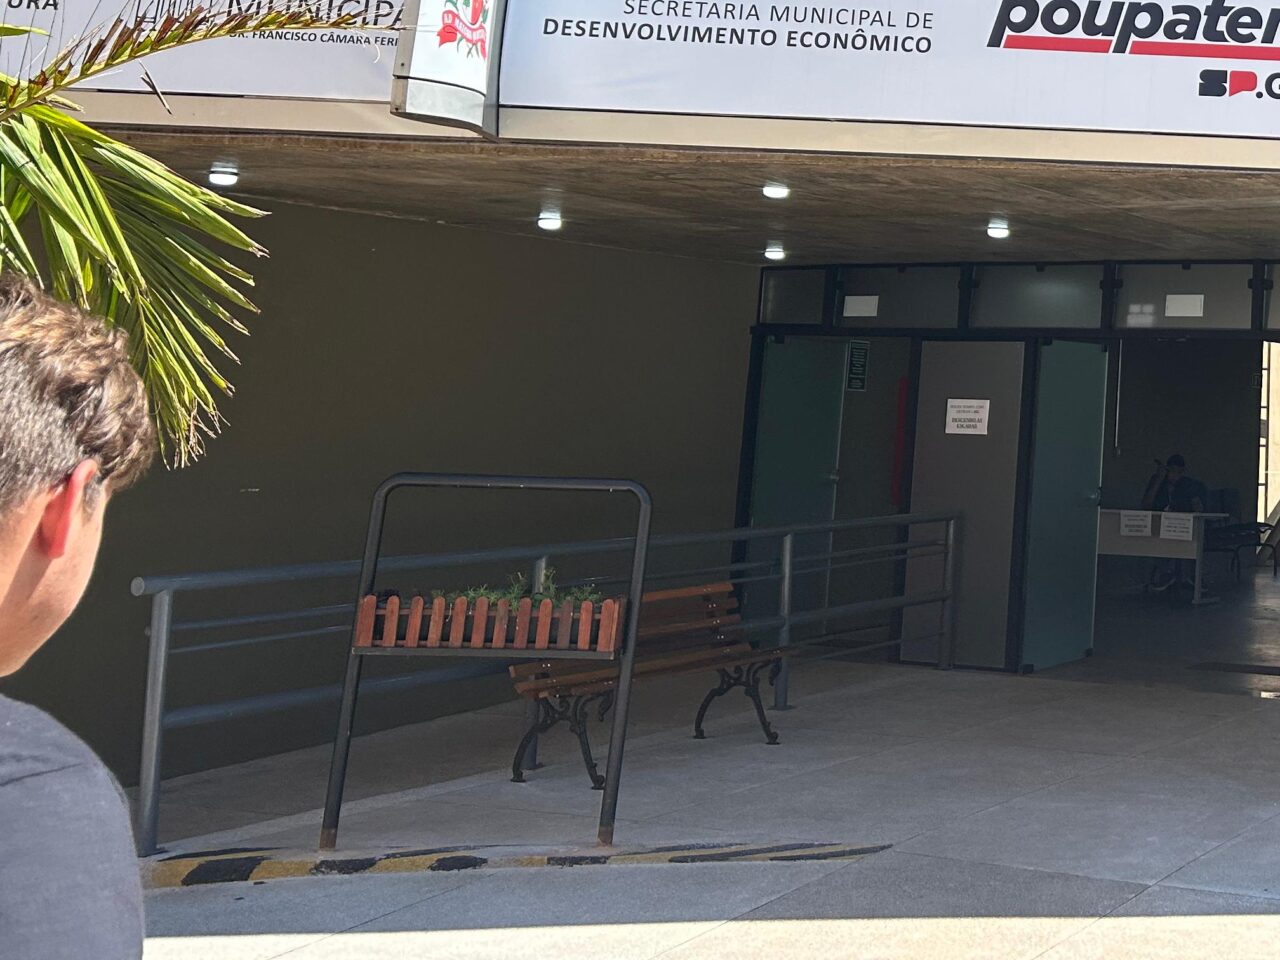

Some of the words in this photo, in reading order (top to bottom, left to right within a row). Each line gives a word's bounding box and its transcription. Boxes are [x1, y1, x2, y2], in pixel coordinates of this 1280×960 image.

[769, 4, 897, 27] MUNICIPAL
[905, 12, 934, 29] DE
[252, 30, 317, 42] FRANCISCO
[320, 32, 371, 45] CÂMARA
[542, 18, 777, 46] DESENVOLVIMENTO
[786, 29, 932, 53] ECONÔMICO
